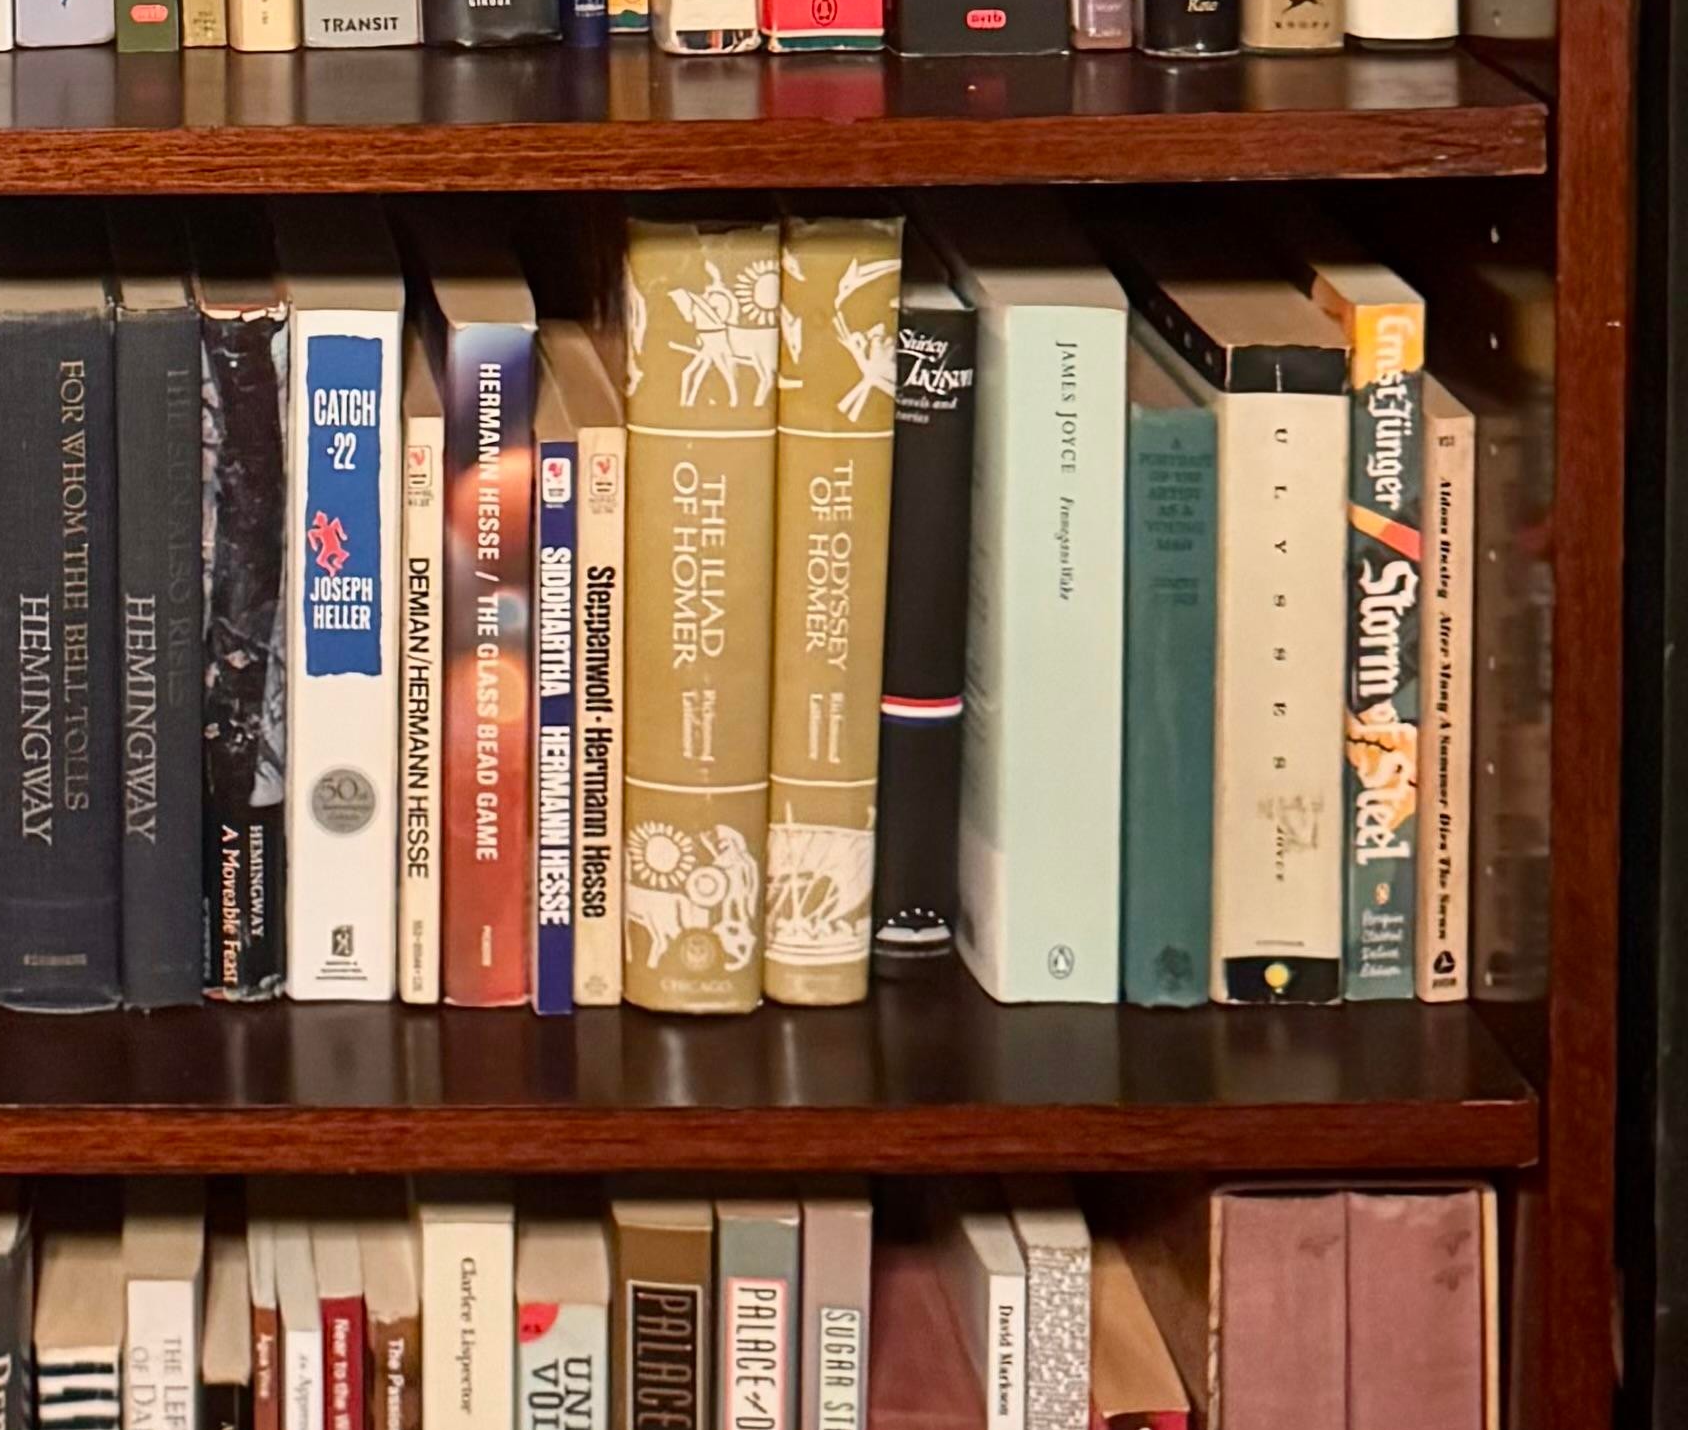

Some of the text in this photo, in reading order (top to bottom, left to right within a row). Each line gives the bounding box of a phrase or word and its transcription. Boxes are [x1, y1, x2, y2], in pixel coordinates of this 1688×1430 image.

[322, 16, 398, 32] TRANSIT
[313, 389, 376, 428] CATCH
[1057, 340, 1078, 475] JAMES JOYCE
[309, 577, 373, 604] JOSEPH
[312, 604, 371, 631] HELLER
[475, 363, 501, 860] HERMANN HESSE THE GLASS BEAD GAME
[673, 461, 698, 668] OF HOMER
[700, 560, 725, 657] ILIAD
[1359, 558, 1418, 696] Storm
[20, 593, 53, 845] HEMINGWAY
[126, 593, 156, 844] HEMINGWAY
[735, 1288, 776, 1387] PALACE
